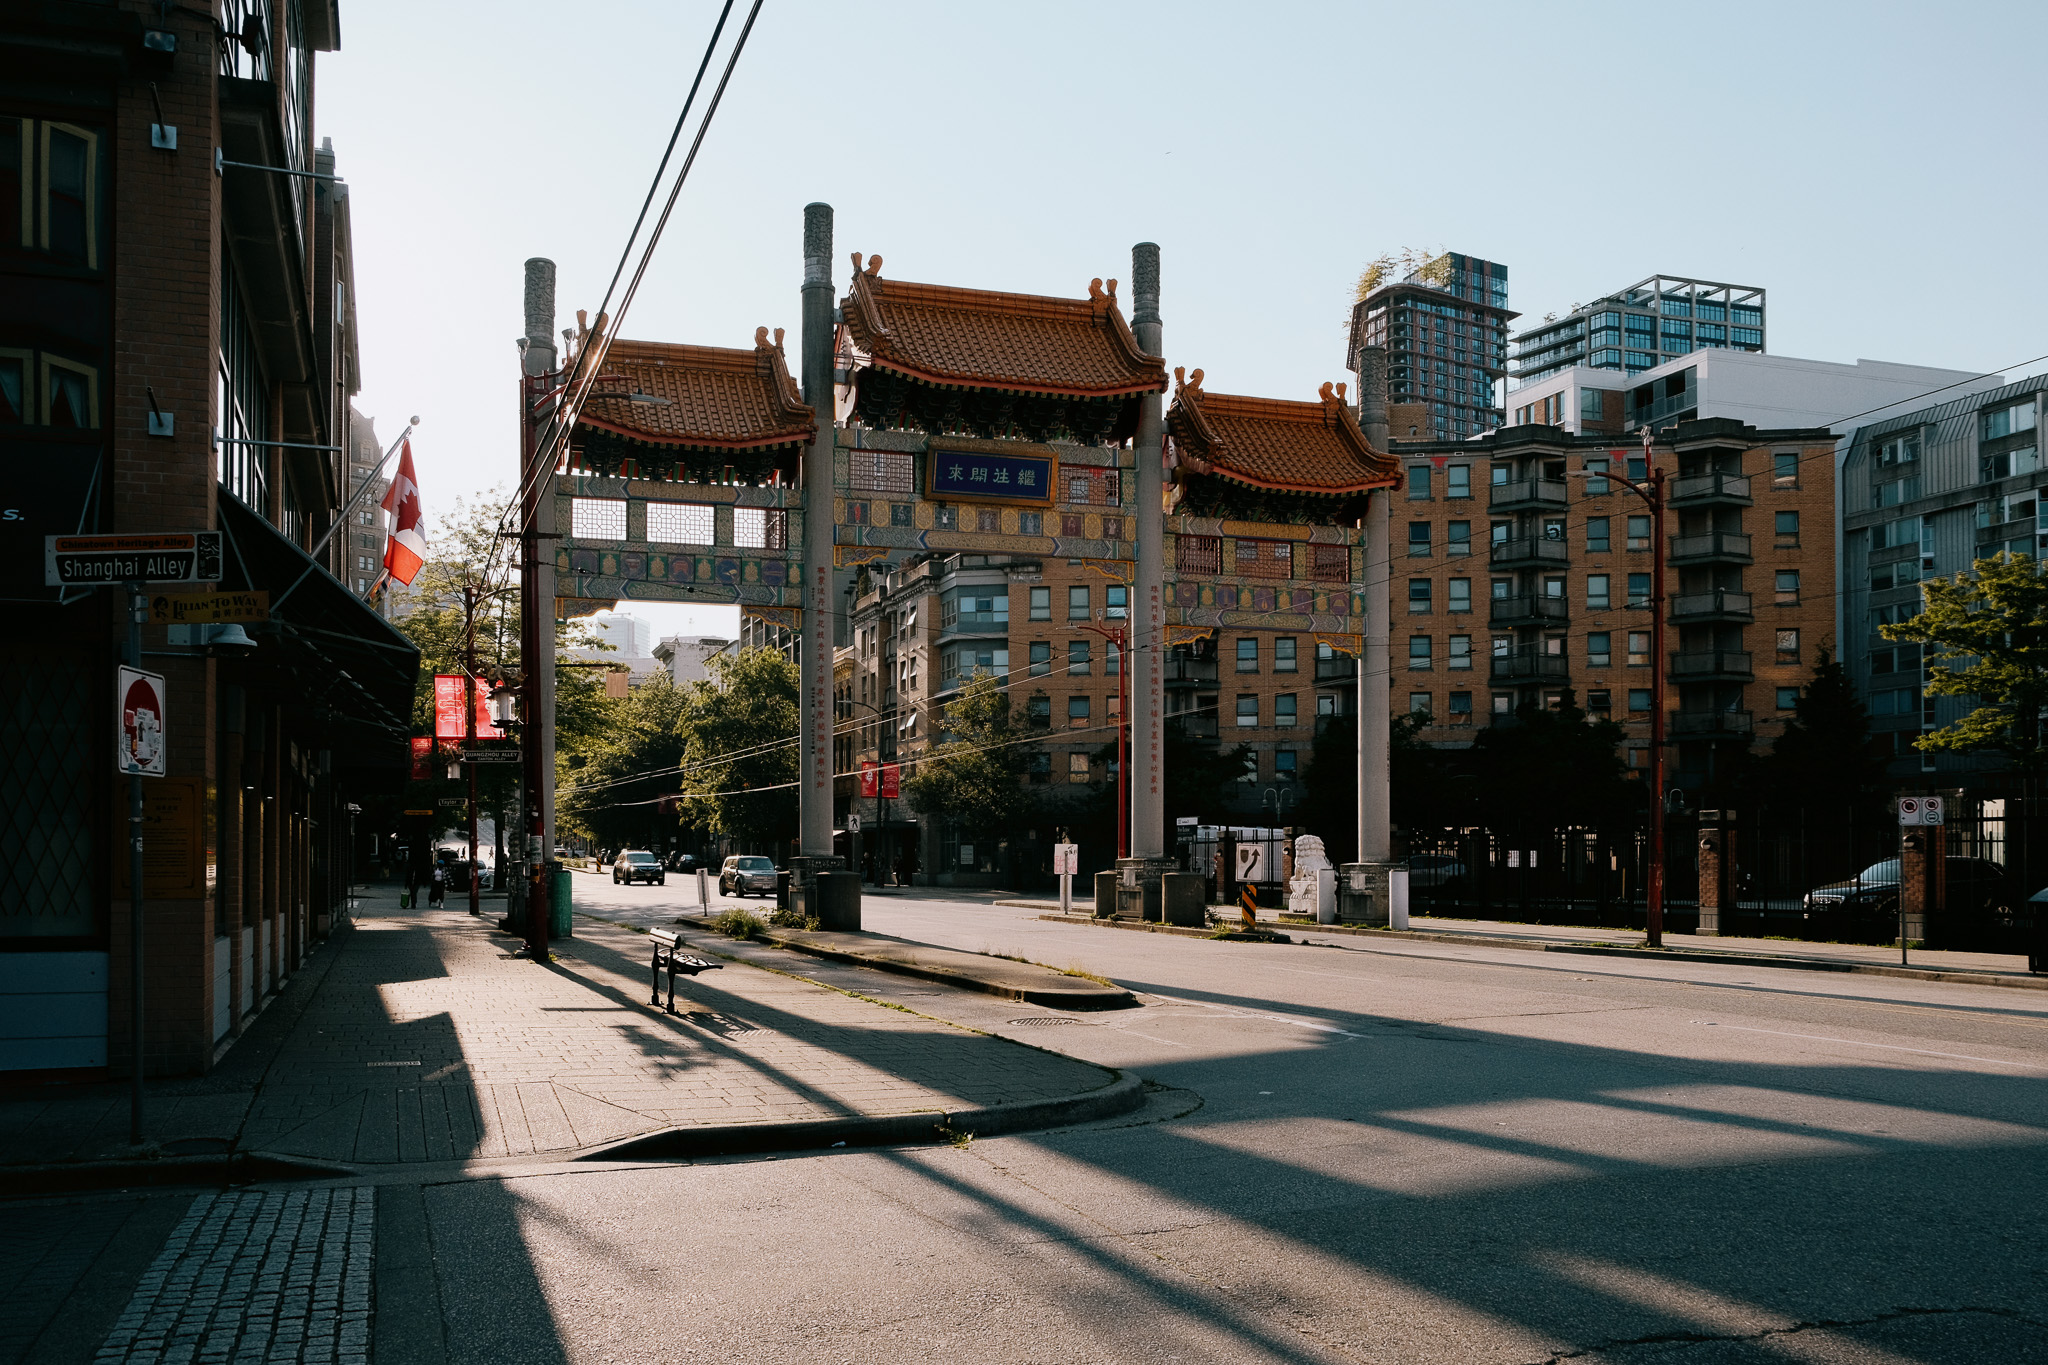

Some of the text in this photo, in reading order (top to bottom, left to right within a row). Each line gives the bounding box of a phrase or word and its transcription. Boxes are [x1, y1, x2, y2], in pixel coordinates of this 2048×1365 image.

[61, 538, 189, 549] Chinatown Heritage Alley
[63, 556, 187, 580] Shanghai Alley
